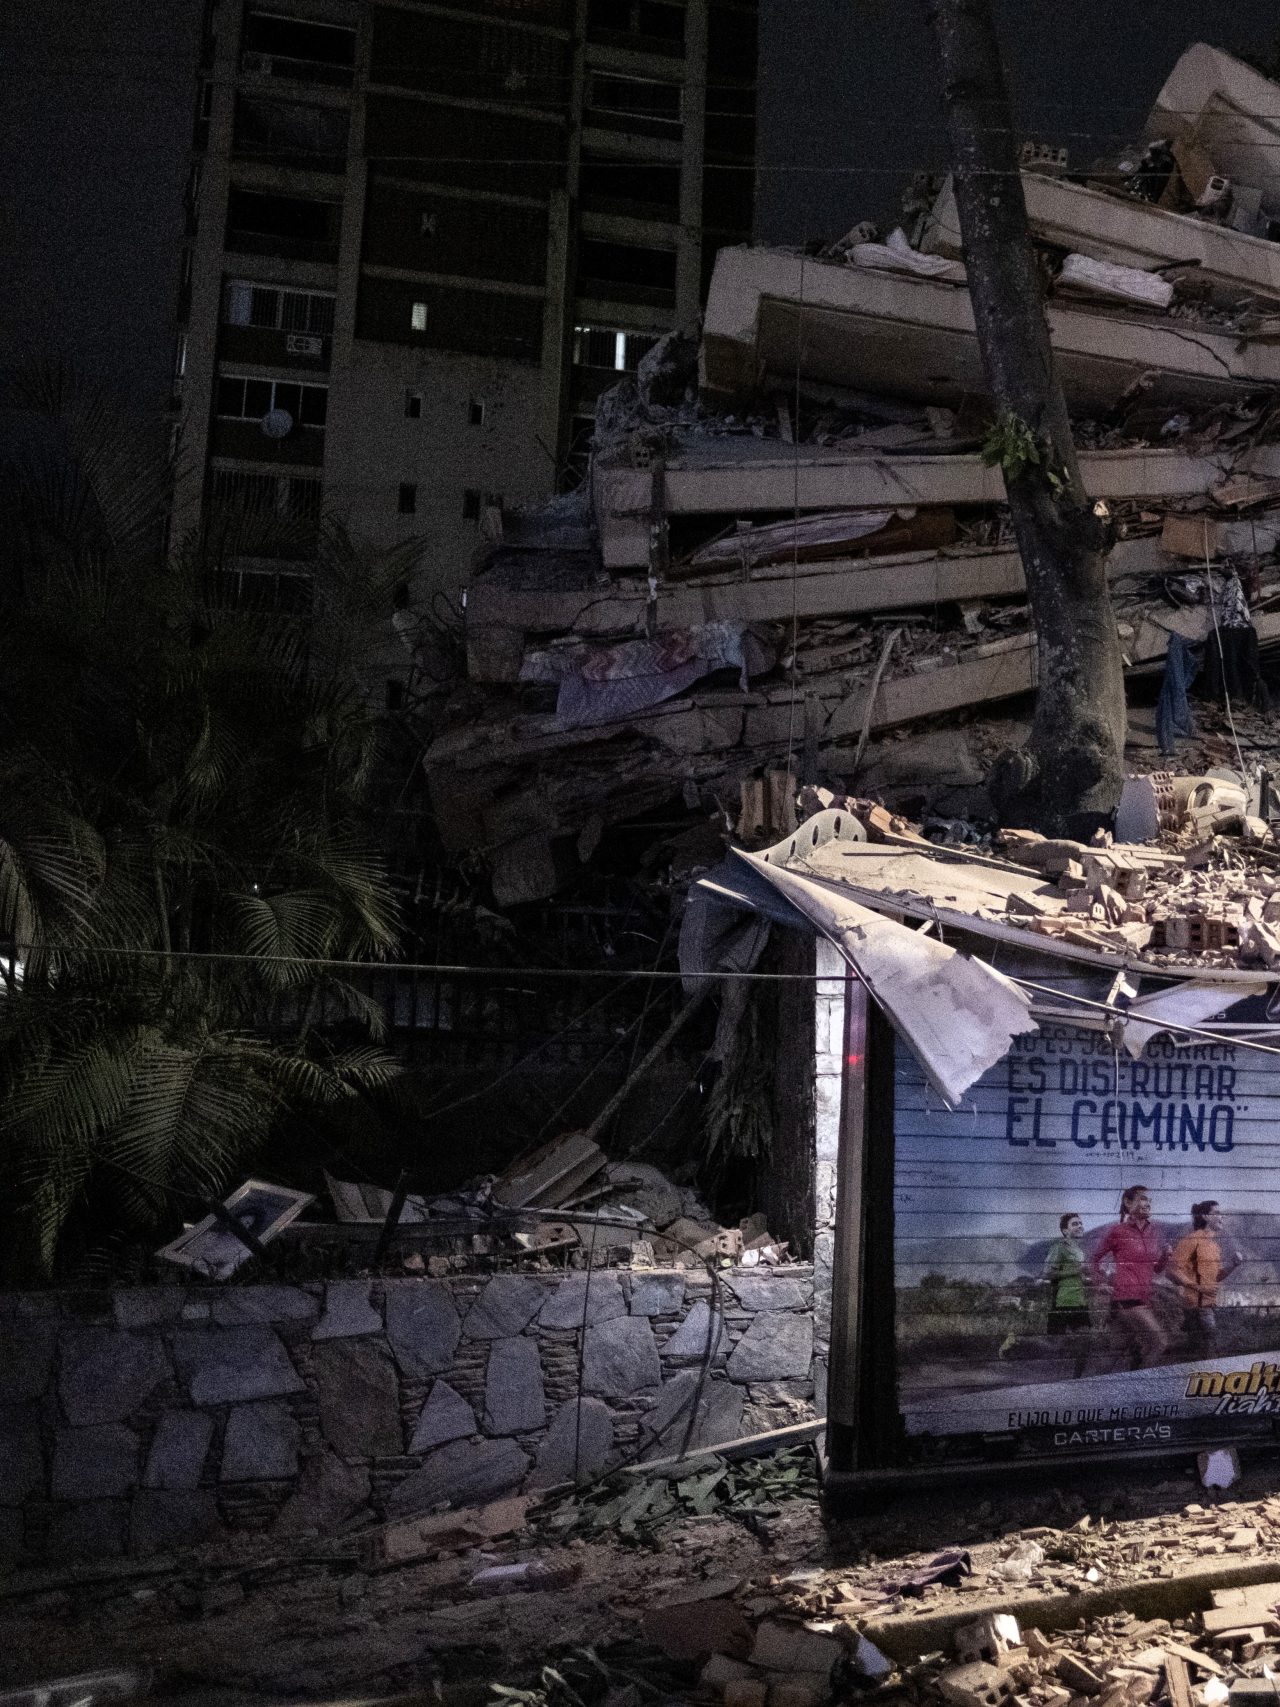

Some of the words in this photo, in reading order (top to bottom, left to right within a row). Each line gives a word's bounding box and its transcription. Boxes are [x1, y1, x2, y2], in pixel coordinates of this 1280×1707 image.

[1008, 1055, 1047, 1096] ES
[1006, 1097, 1056, 1147] EL
[1008, 1412, 1050, 1428] ELIJO
[1055, 1410, 1073, 1424] LO
[1077, 1408, 1104, 1424] QUE
[1110, 1406, 1128, 1421] ME
[1133, 1404, 1179, 1419] GUSTA
